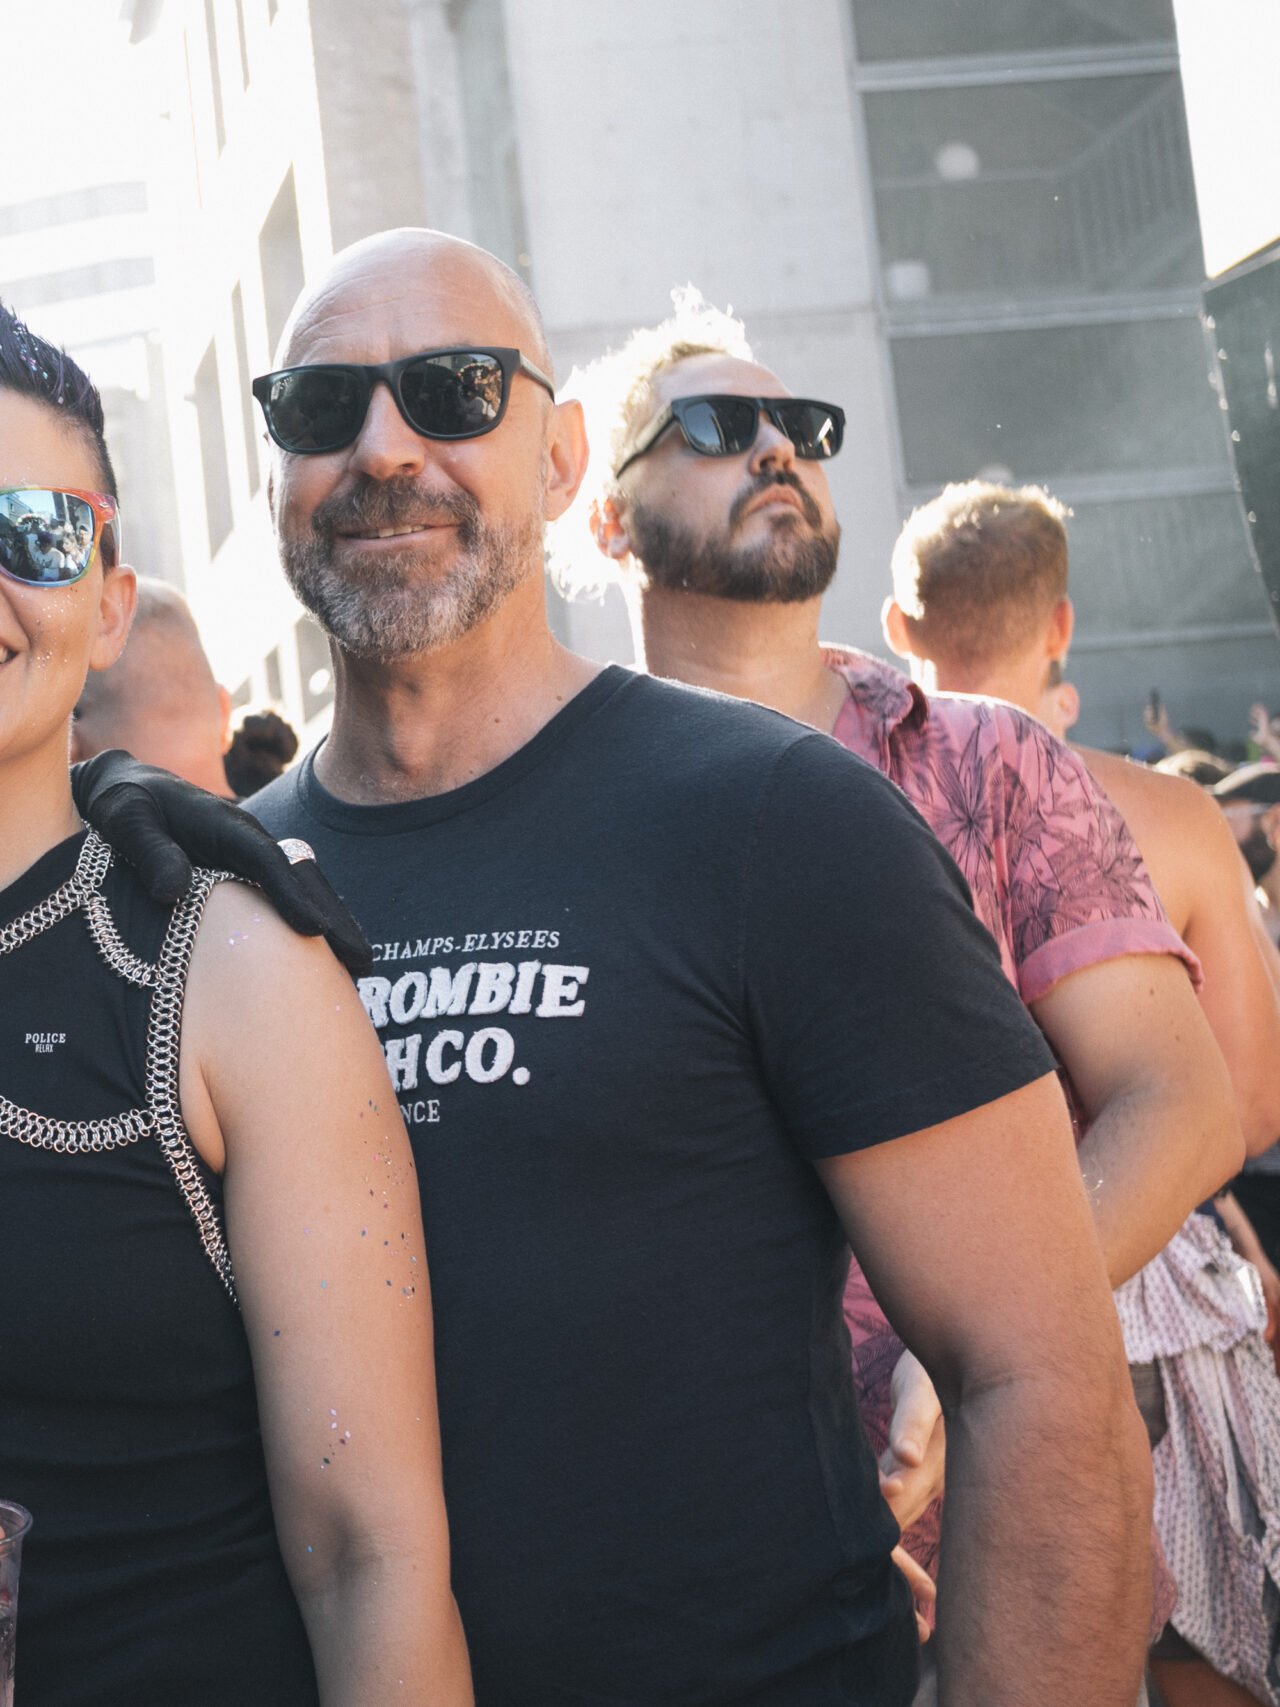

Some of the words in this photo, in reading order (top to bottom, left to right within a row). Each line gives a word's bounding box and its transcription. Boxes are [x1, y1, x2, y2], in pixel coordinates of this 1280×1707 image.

[371, 930, 560, 961] CHAMPS-ELYSEES
[25, 1032, 66, 1044] POLICE
[35, 1043, 54, 1053] RELAX
[381, 1027, 531, 1092] HCO.
